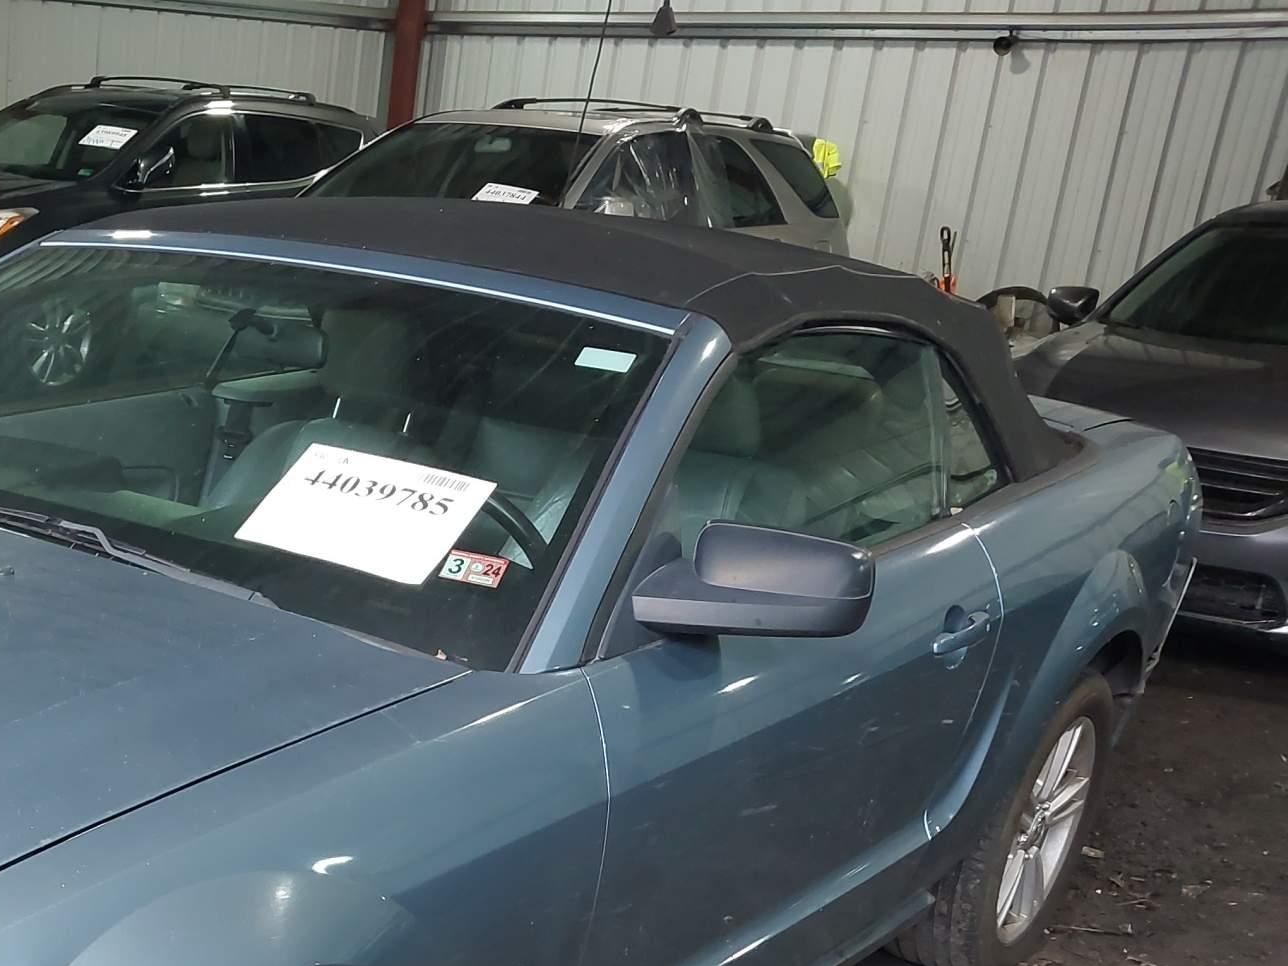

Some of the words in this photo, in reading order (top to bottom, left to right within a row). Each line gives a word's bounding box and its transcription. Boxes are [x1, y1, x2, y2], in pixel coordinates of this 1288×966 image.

[303, 469, 456, 517] 44039785
[448, 558, 465, 574] 3
[482, 563, 503, 578] 24
